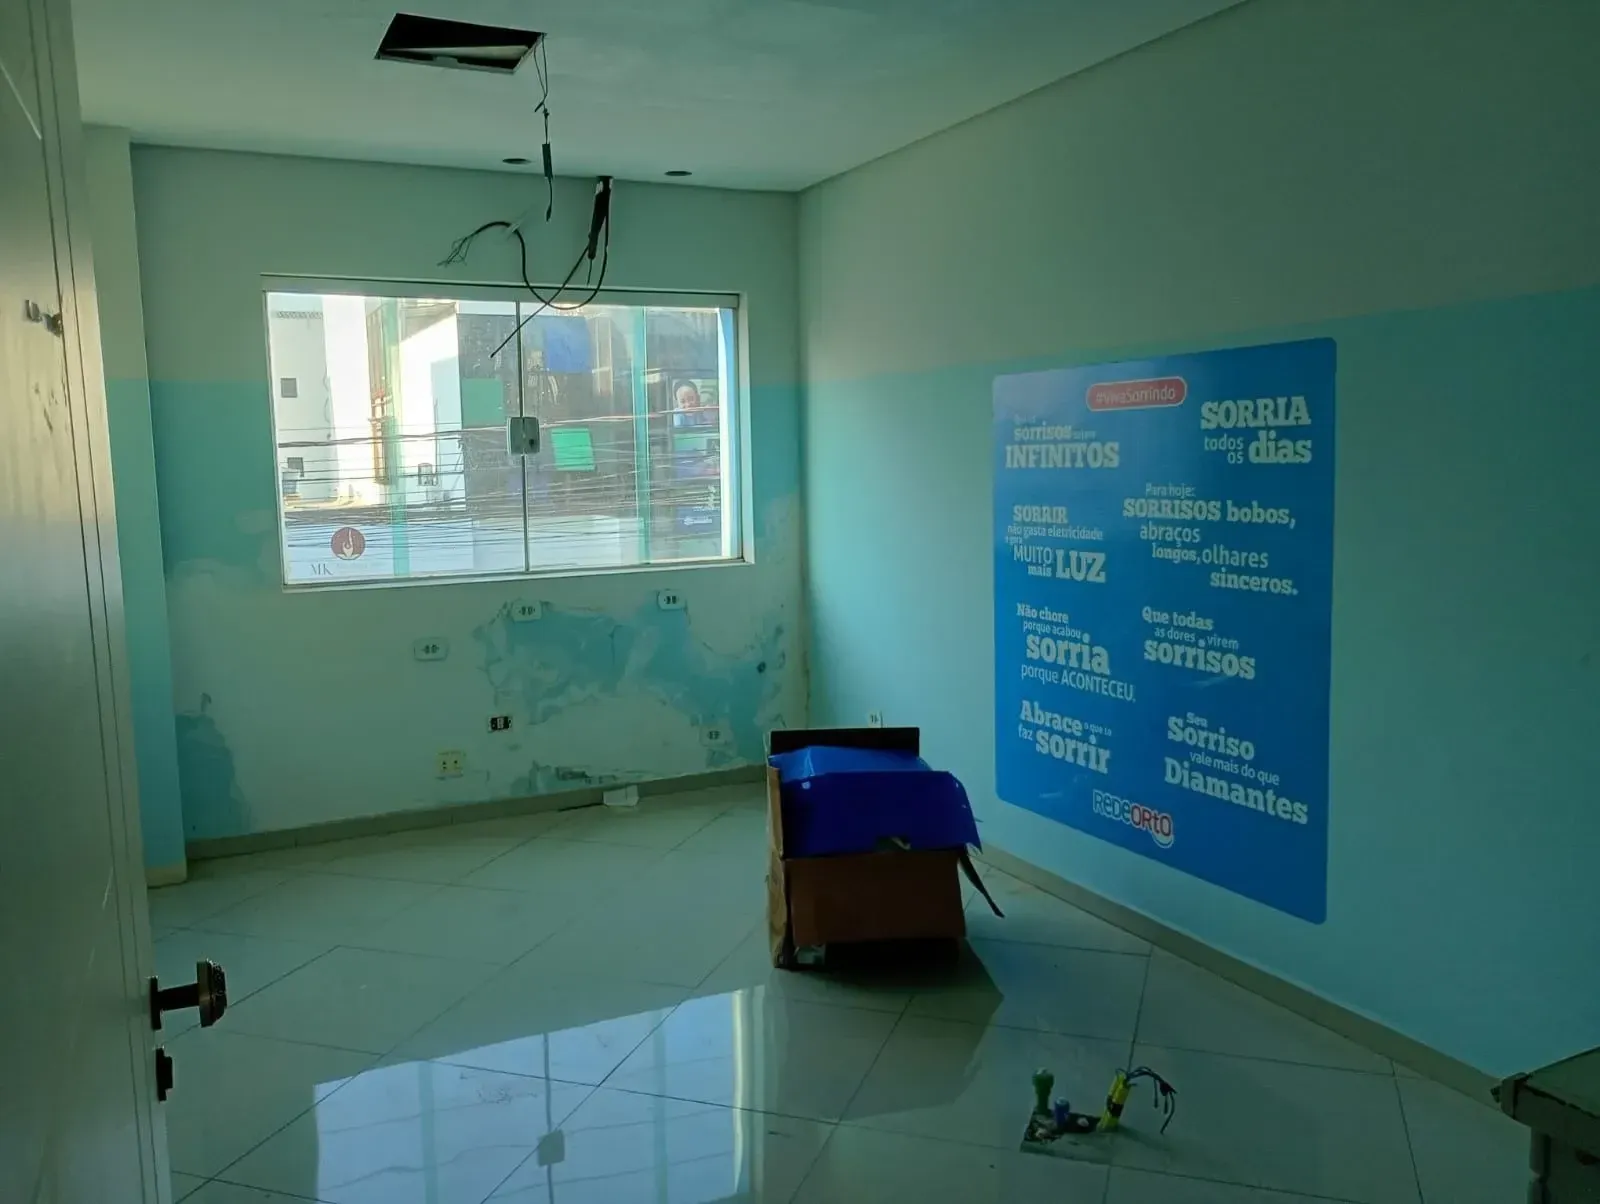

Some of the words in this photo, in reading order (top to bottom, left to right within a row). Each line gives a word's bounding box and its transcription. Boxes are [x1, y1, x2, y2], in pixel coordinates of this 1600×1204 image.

[1200, 396, 1312, 430] SORRIA
[1204, 433, 1244, 451] todos
[1248, 430, 1312, 464] dias
[1005, 442, 1120, 469] INFINITOS
[1227, 451, 1244, 465] os
[1145, 482, 1167, 497] Para
[1168, 482, 1196, 499] hoje:
[1013, 504, 1068, 524] SORRIR
[1123, 498, 1221, 521] SORRISOS
[1226, 499, 1296, 529] bobos,
[1007, 523, 1021, 536] não
[1023, 525, 1046, 539] gasta
[1048, 524, 1104, 541] eletricidade
[1140, 521, 1201, 547] abraços
[1013, 544, 1053, 565] MUITO
[1055, 549, 1106, 584] LUZ
[1152, 542, 1201, 565] longos,
[1202, 544, 1269, 569] olhares
[1027, 564, 1052, 577] mais
[1210, 567, 1298, 596] sinceros.
[1016, 602, 1038, 618] Não
[1039, 606, 1069, 624] chore
[1142, 606, 1170, 624] Que
[1172, 611, 1214, 631] todas
[1023, 620, 1051, 634] porque
[1052, 624, 1081, 639] acabou
[1154, 628, 1165, 638] as
[1167, 626, 1196, 643] dores
[1207, 633, 1239, 650] virem
[1026, 633, 1110, 675] sorria
[1144, 639, 1256, 680] sorrisos
[1021, 664, 1059, 685] porque
[1020, 699, 1082, 736] Abrace
[1186, 711, 1208, 728] Seu
[1018, 722, 1033, 741] faz
[1035, 729, 1111, 774] sorrir
[1168, 716, 1255, 760] Sorriso
[1189, 751, 1212, 768] vale
[1213, 758, 1239, 775] mais
[1241, 763, 1256, 779] do
[1257, 769, 1280, 787] que
[1164, 756, 1308, 825] Diamantes
